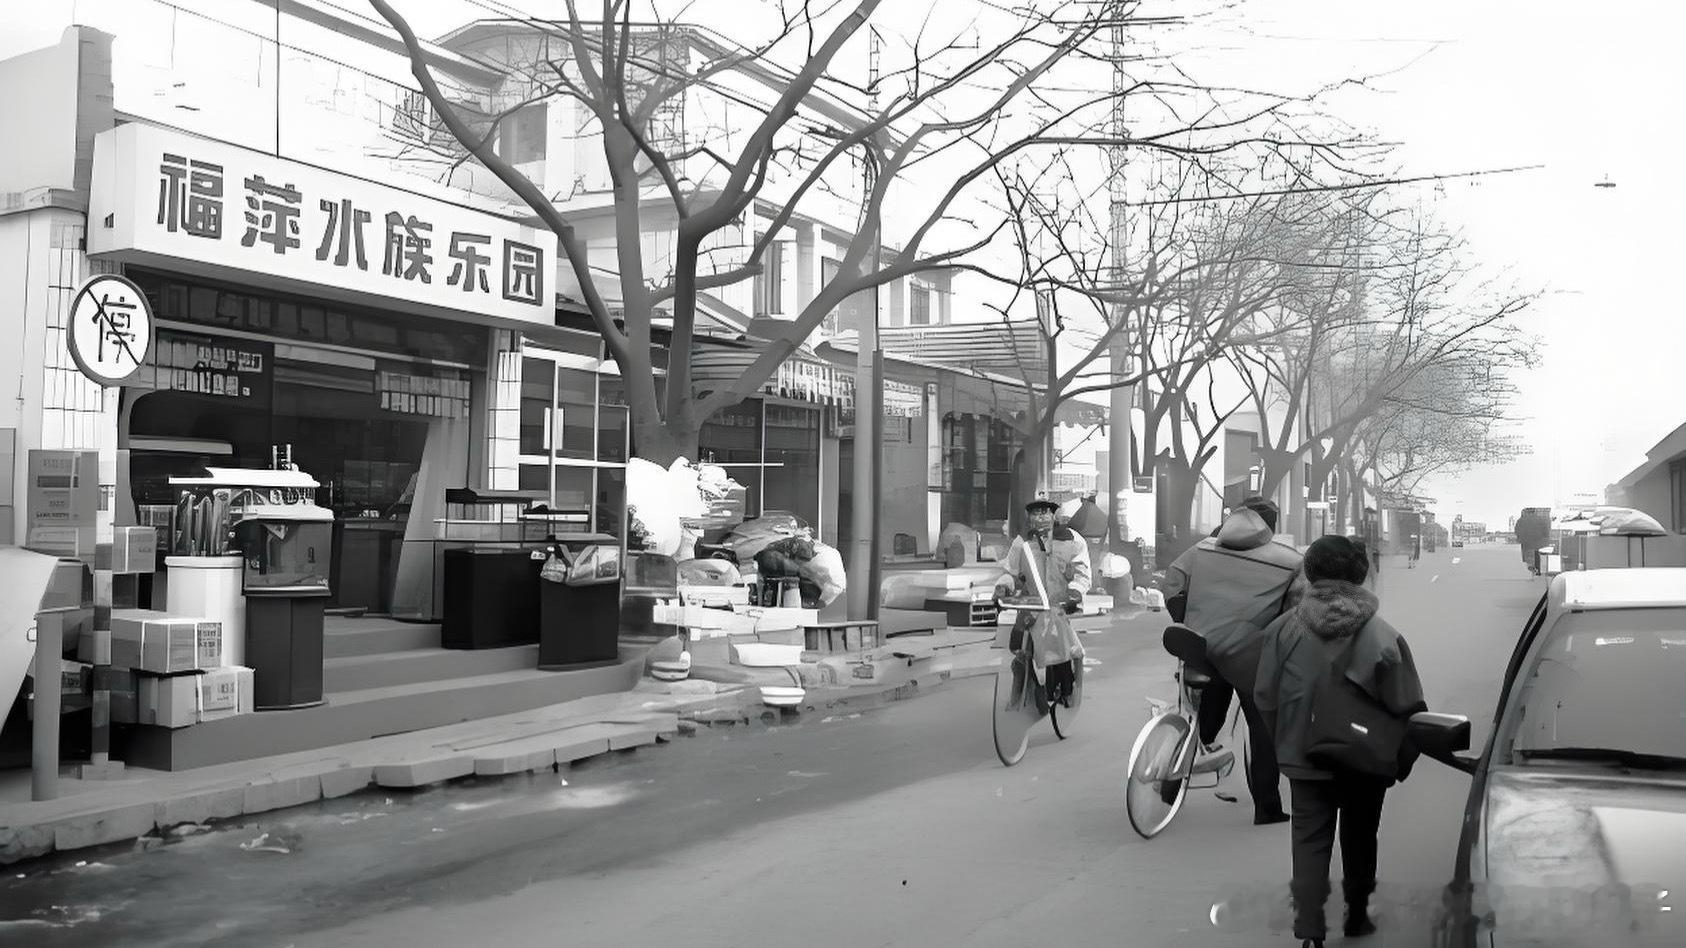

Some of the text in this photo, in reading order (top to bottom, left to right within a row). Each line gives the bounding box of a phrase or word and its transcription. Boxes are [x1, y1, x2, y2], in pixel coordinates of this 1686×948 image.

[157, 152, 544, 306] 福萍水族乐园
